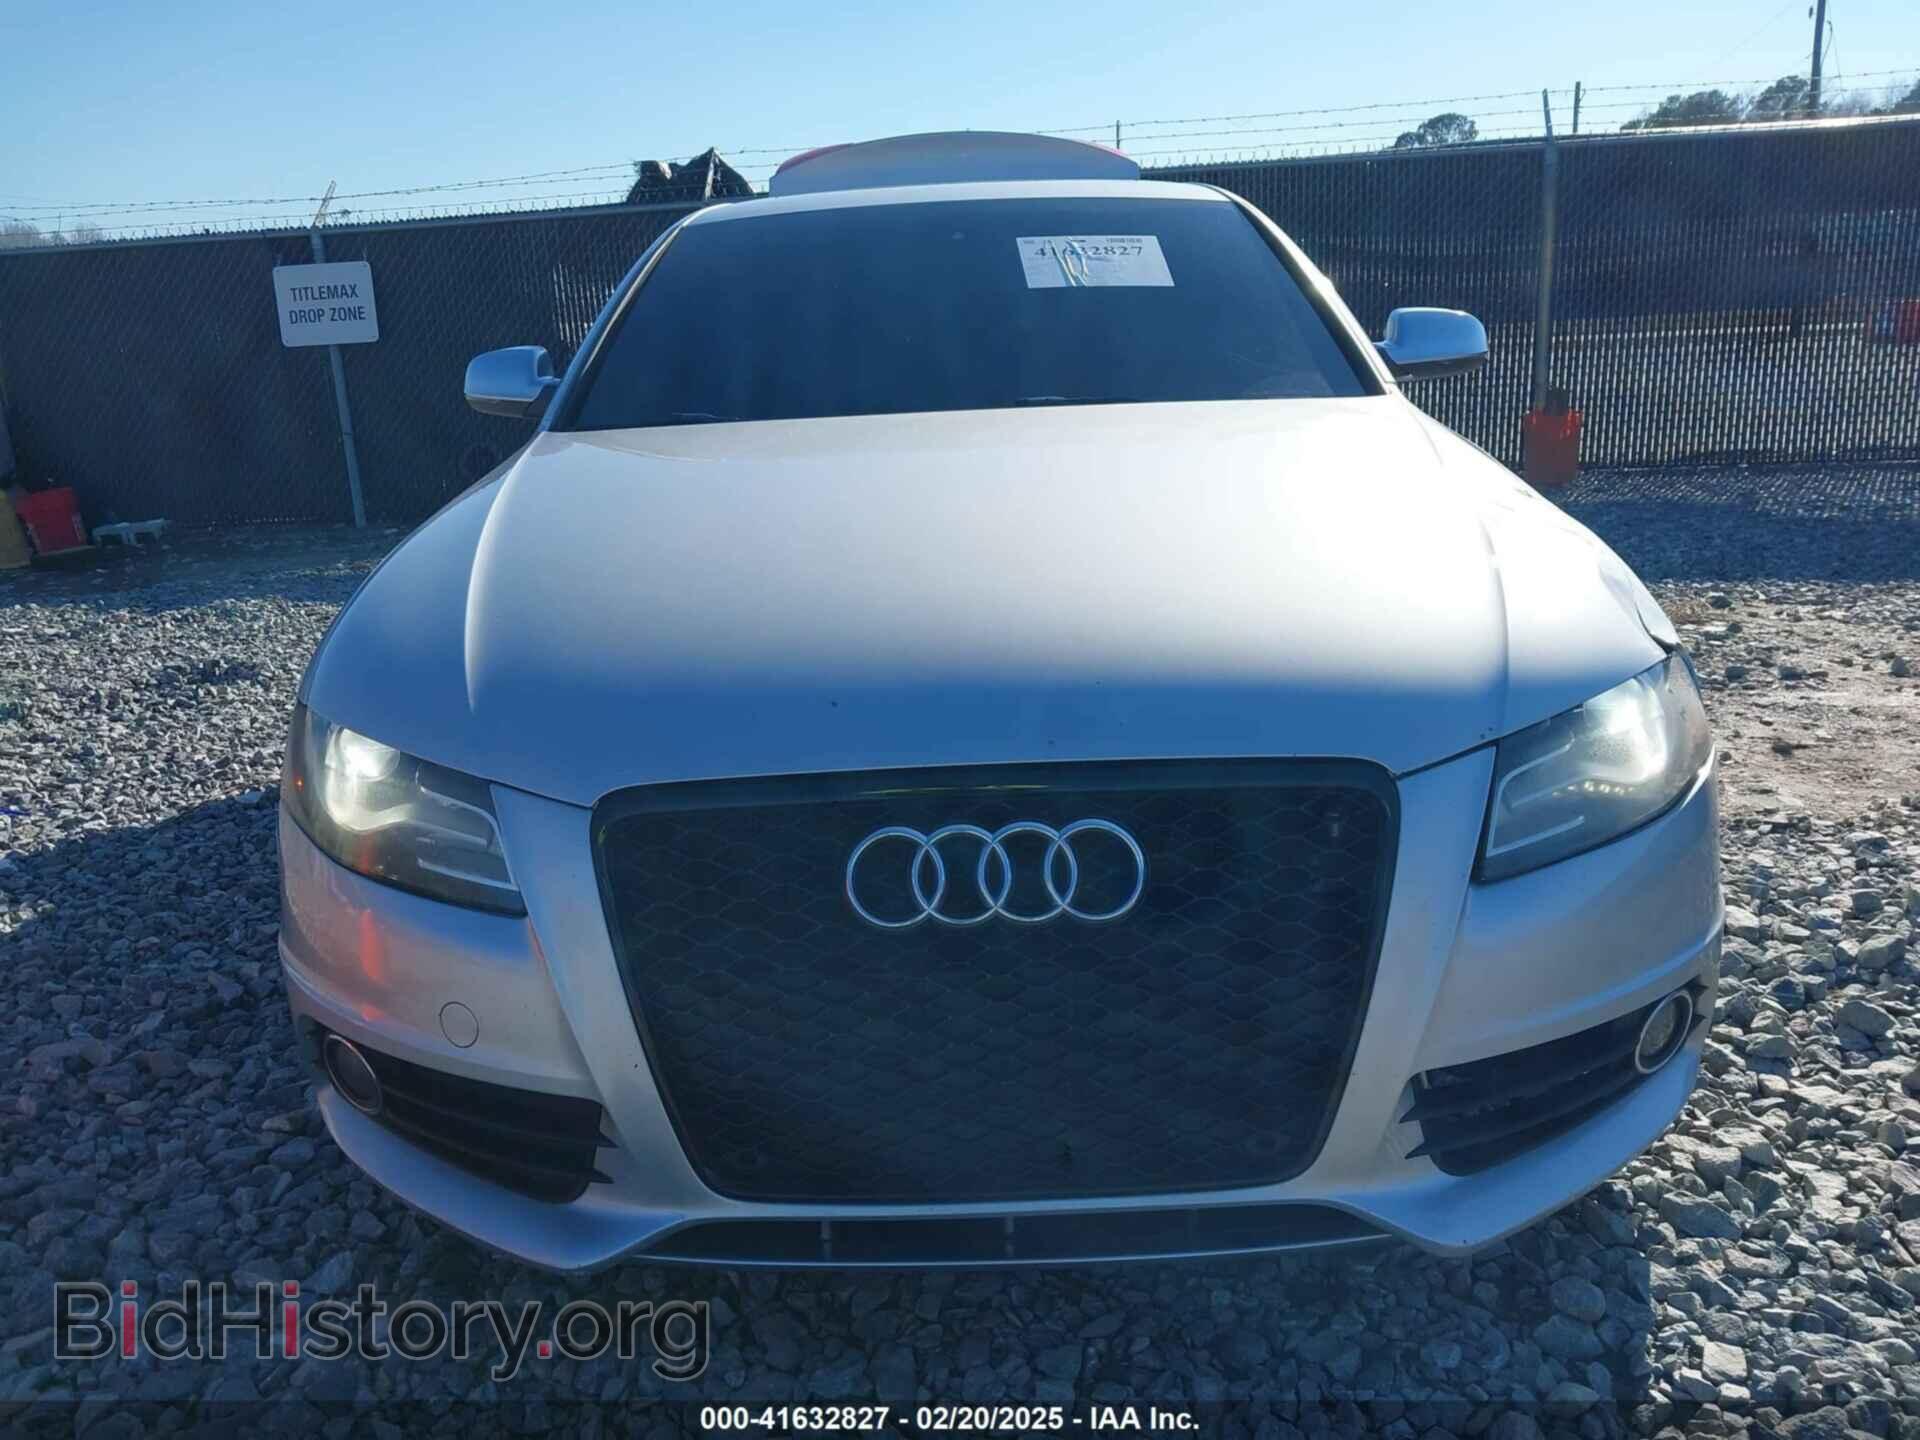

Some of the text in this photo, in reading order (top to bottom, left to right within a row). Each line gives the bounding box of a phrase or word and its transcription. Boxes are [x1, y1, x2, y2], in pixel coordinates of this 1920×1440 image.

[290, 284, 359, 302] TITLEMAX
[289, 305, 366, 324] DROP ZONE
